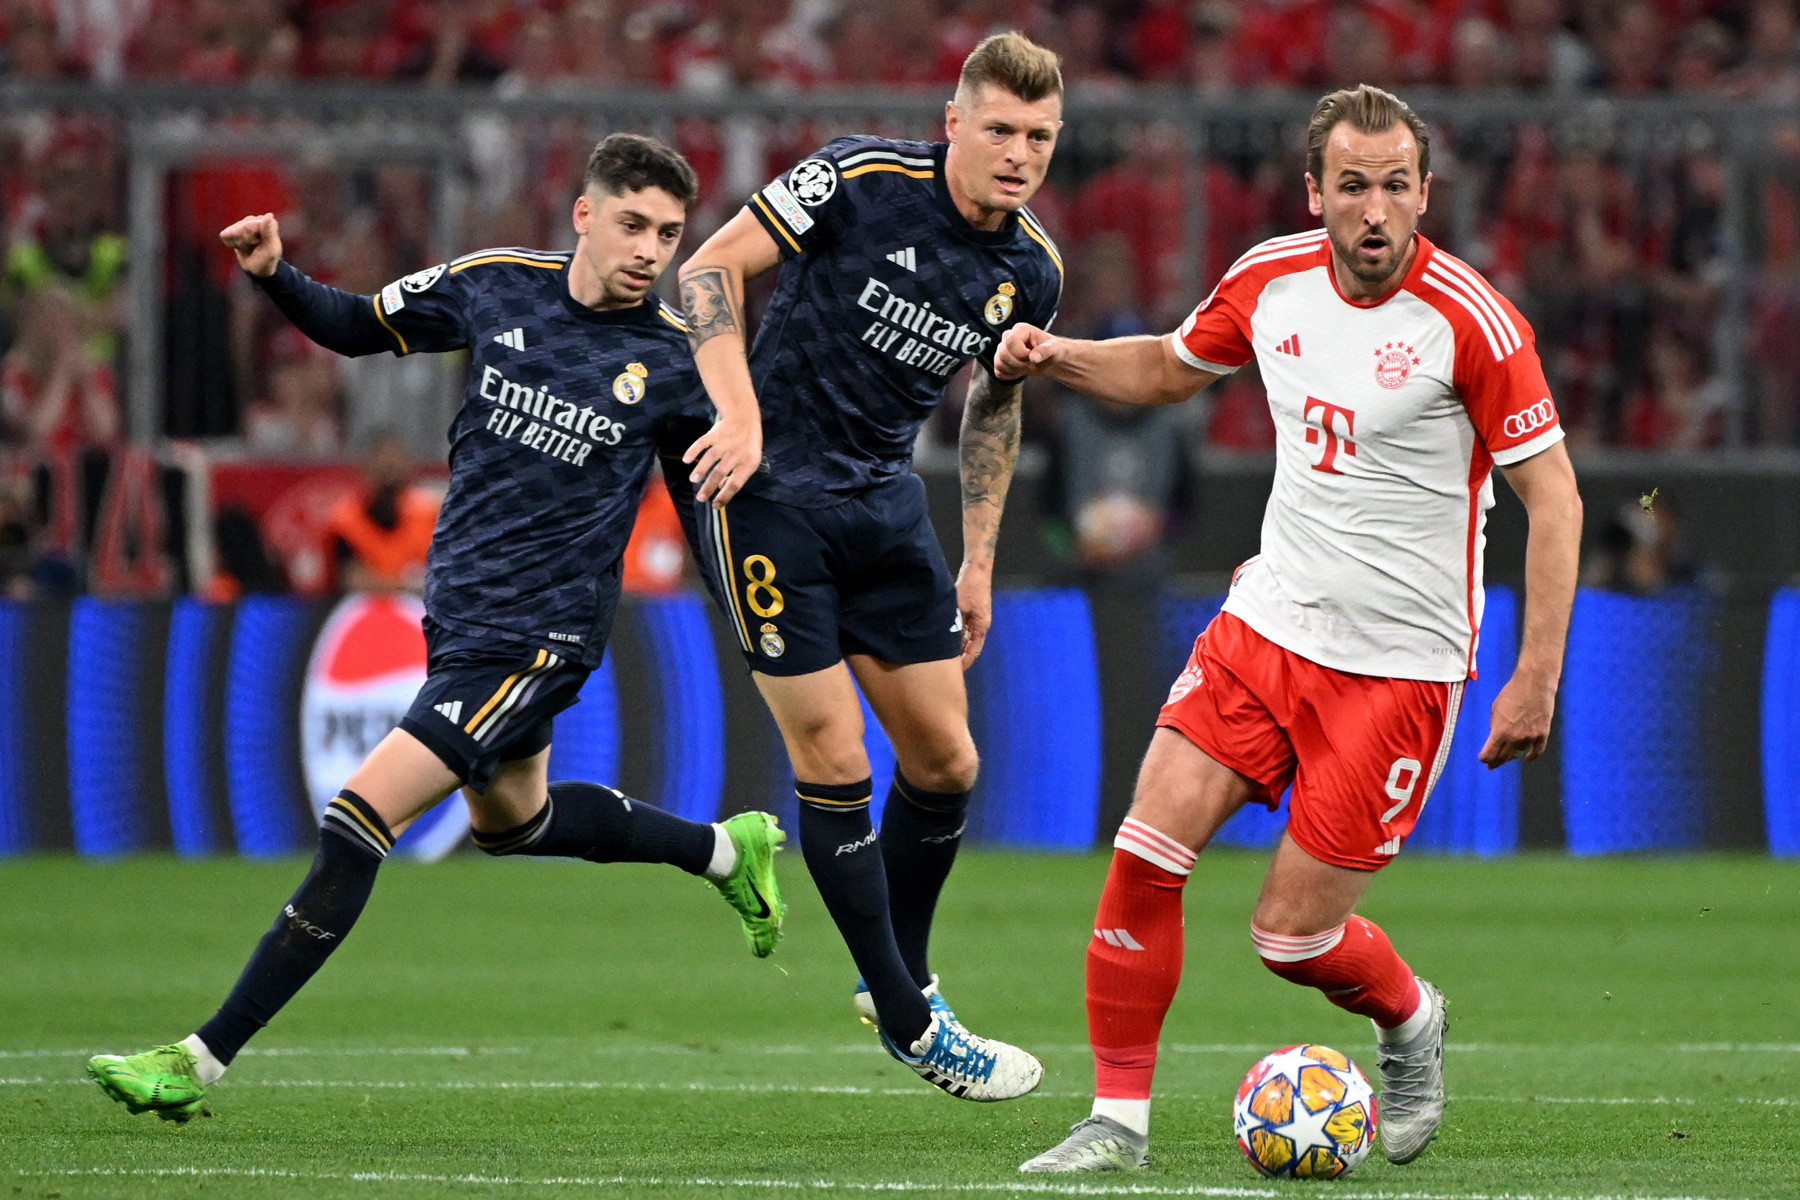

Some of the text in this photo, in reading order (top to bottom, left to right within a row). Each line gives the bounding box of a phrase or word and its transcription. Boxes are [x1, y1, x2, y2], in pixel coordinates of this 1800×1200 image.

[857, 277, 992, 356] Emirates
[861, 321, 961, 376] FLY BETTER
[479, 364, 627, 446] Emirates
[486, 408, 593, 467] FLY BETTER
[1303, 395, 1356, 475] T
[743, 554, 785, 618] 8
[1381, 757, 1422, 823] 9
